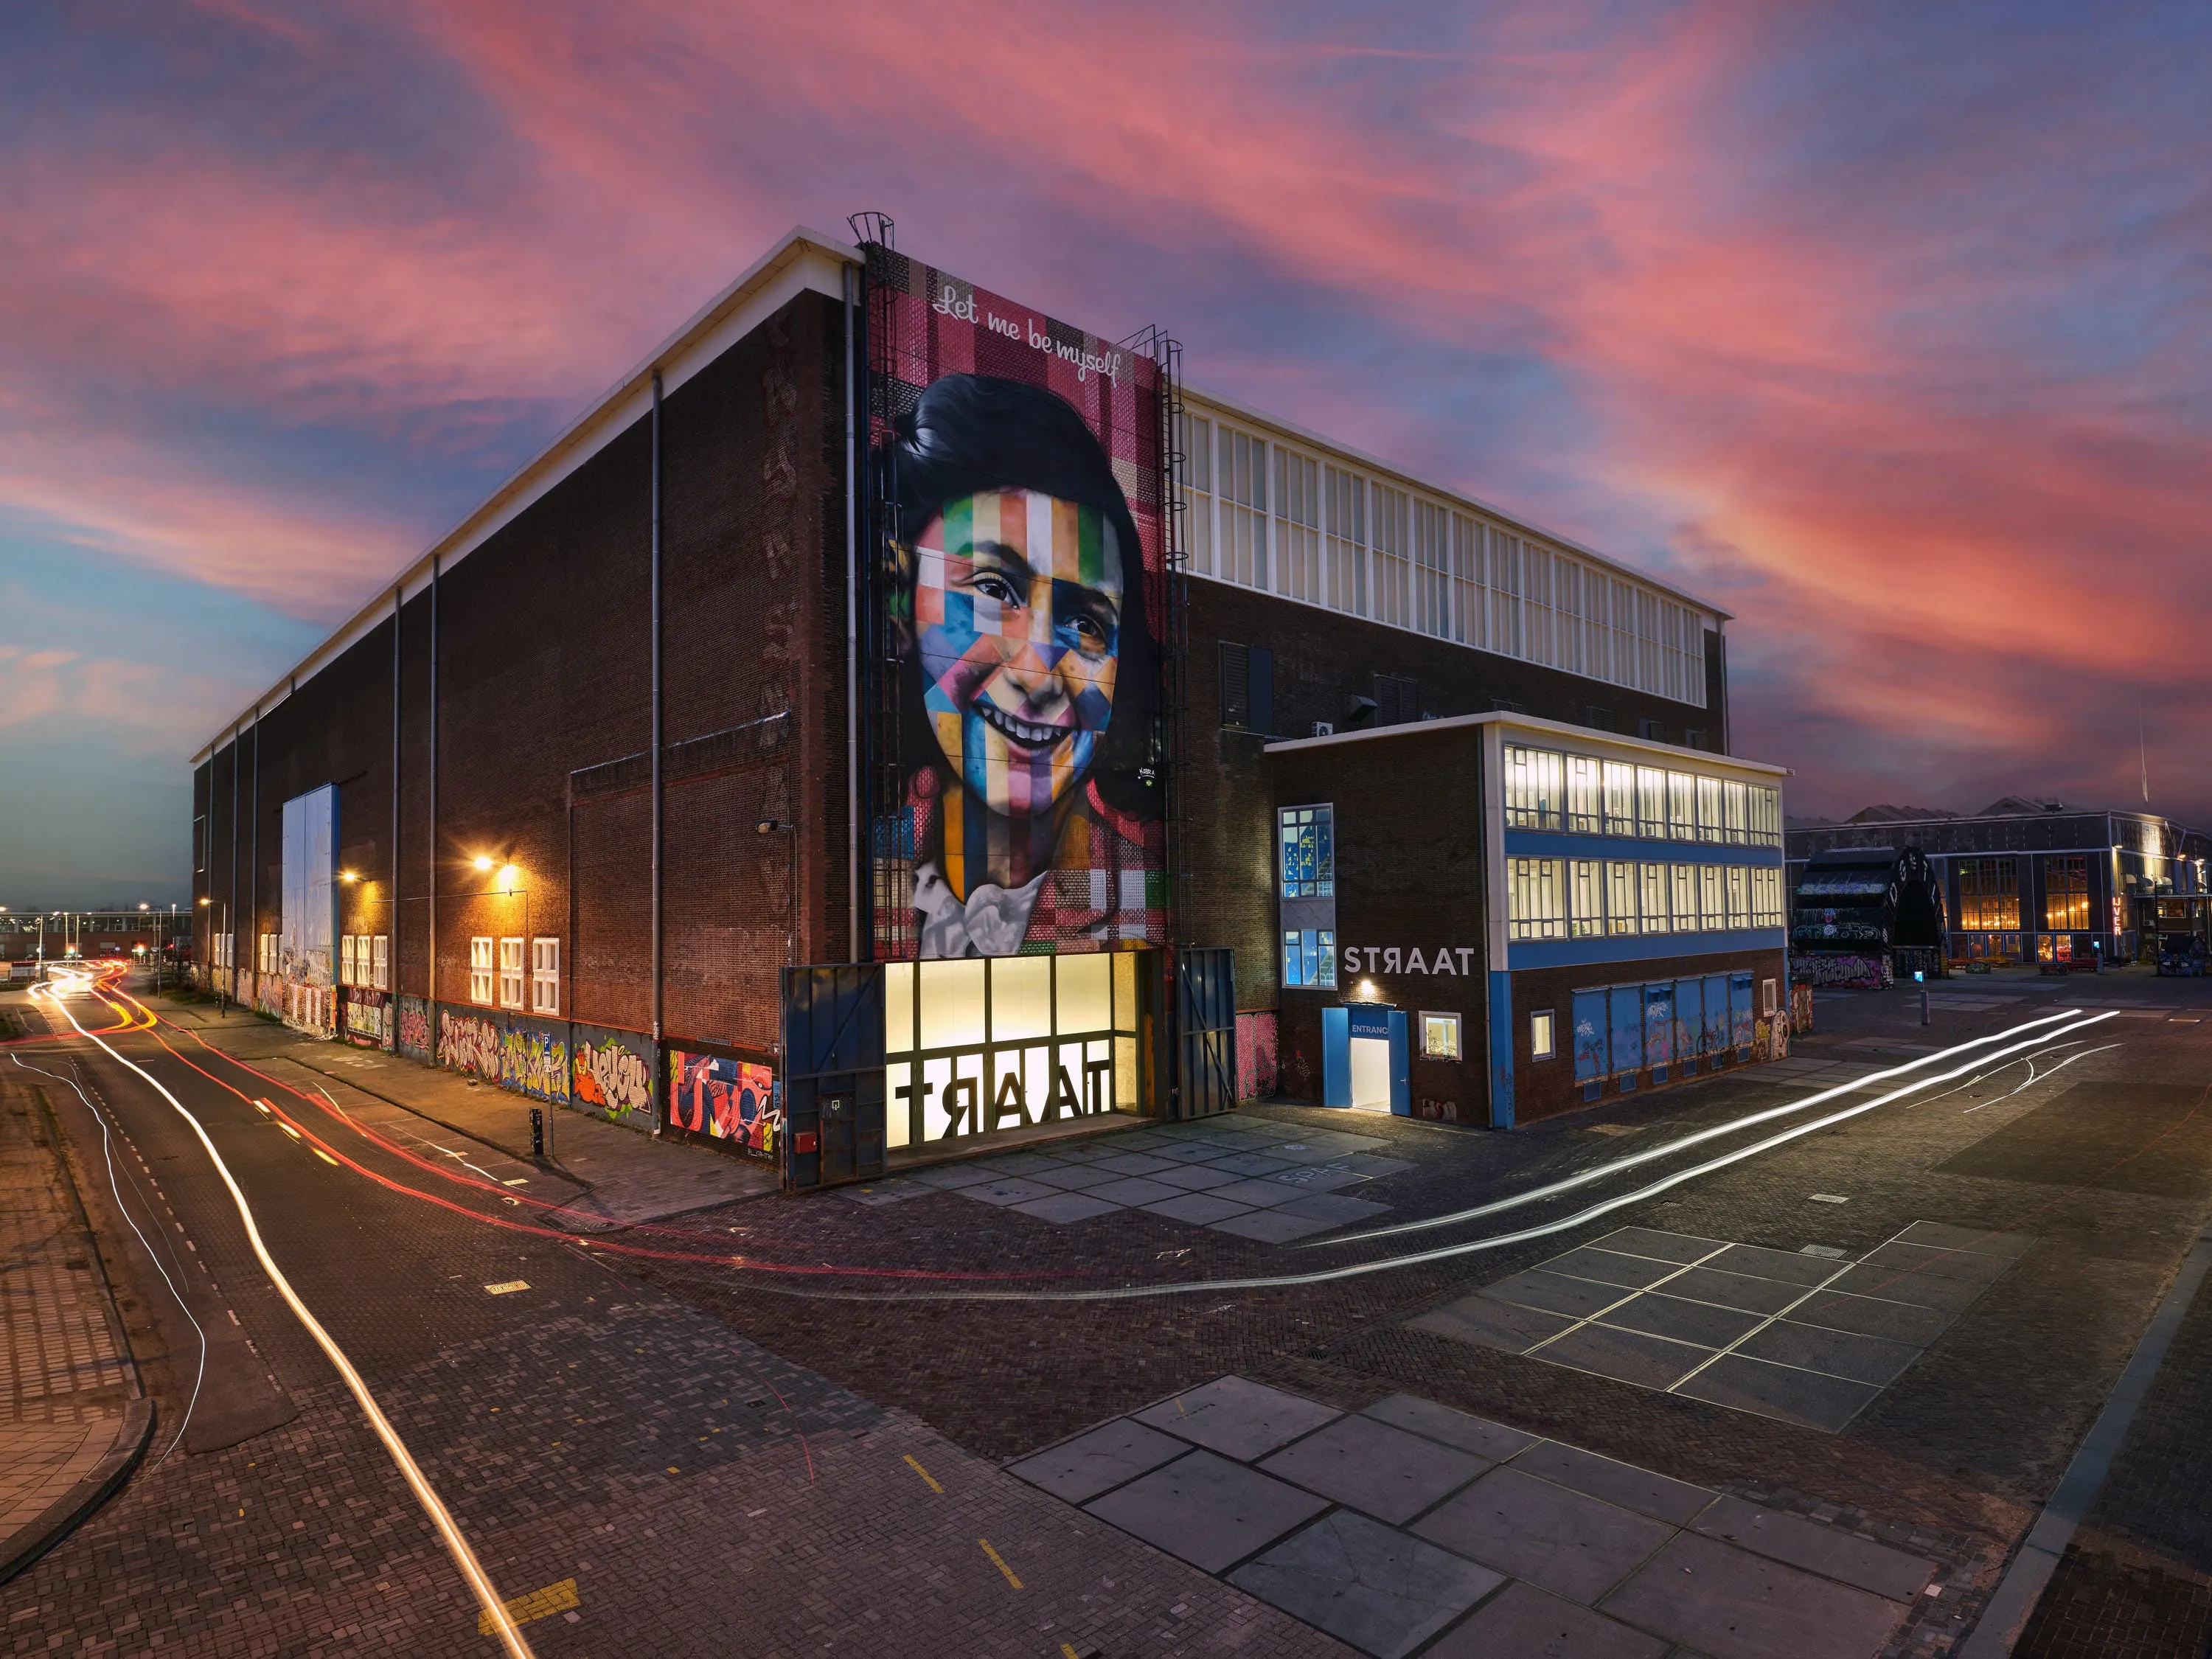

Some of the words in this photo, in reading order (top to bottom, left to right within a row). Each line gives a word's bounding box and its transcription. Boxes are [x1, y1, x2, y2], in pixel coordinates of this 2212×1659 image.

[932, 285, 978, 324] Let
[987, 311, 1020, 341] me
[1028, 318, 1053, 354] be
[1056, 339, 1121, 388] myself
[544, 1036, 549, 1048] P
[1352, 1024, 1389, 1035] ENTRANC
[894, 1058, 1110, 1144] TRAAT
